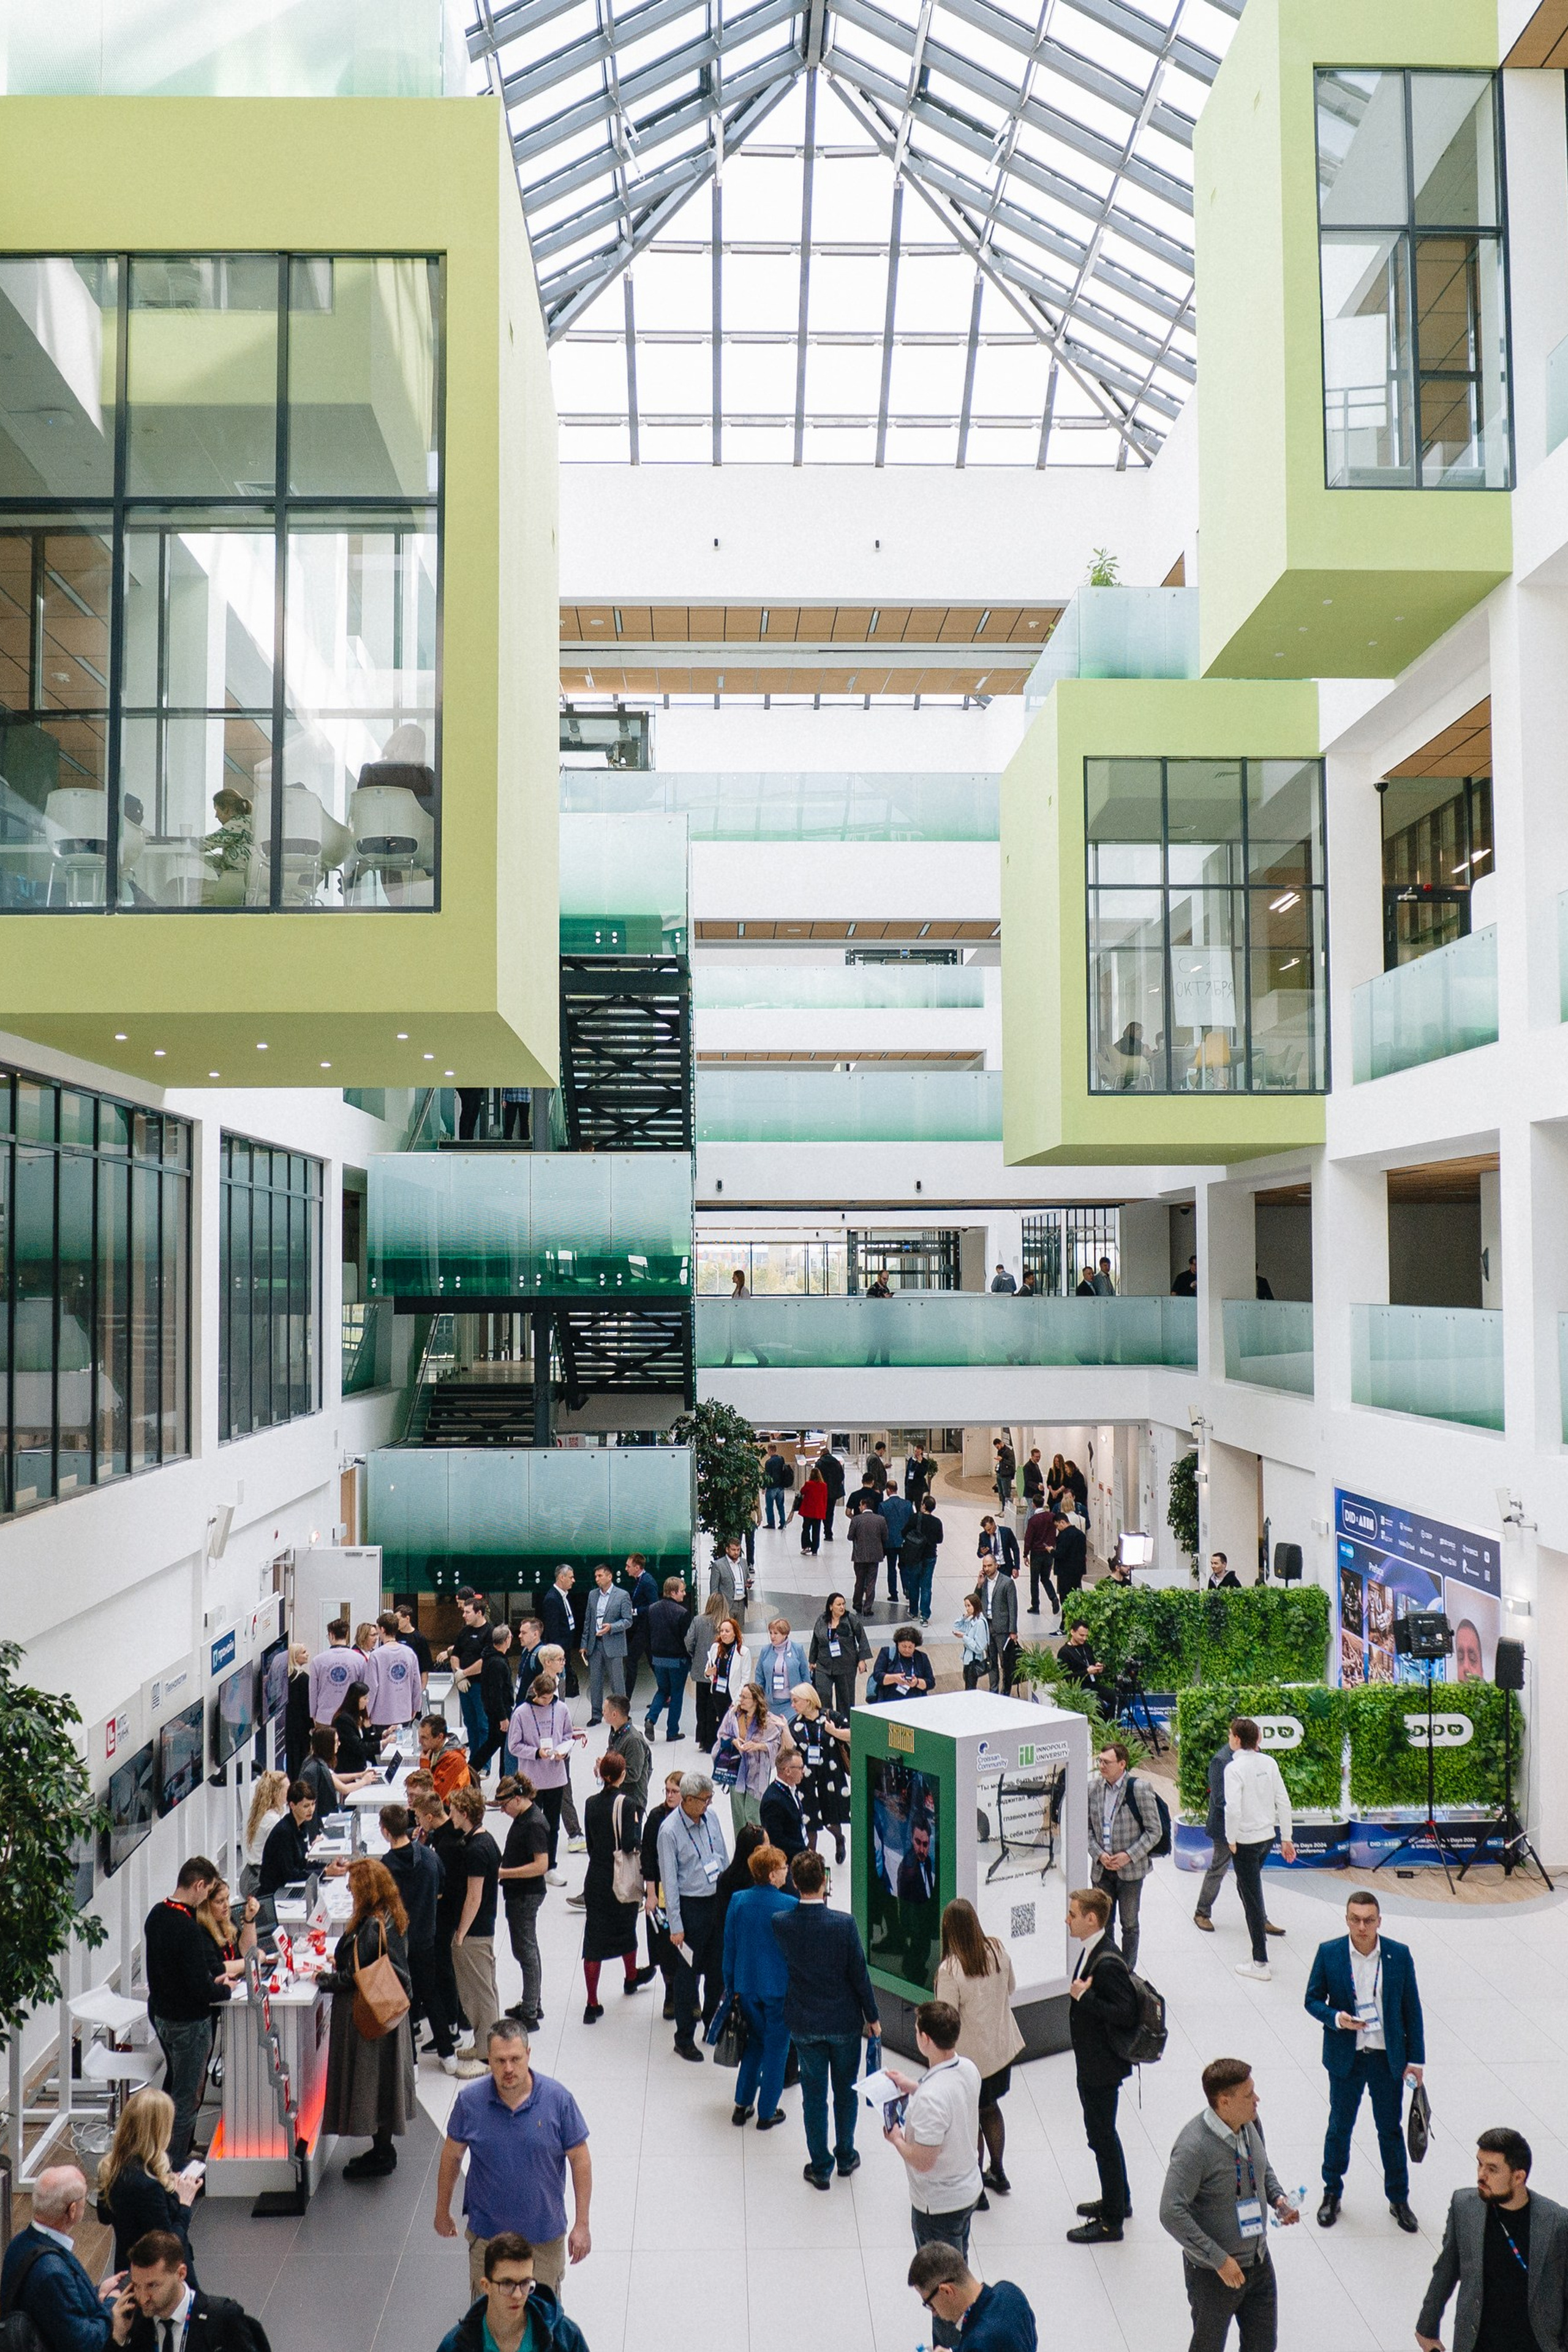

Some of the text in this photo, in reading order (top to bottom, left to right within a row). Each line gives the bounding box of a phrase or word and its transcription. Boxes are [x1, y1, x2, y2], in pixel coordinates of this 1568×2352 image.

[1177, 981, 1233, 998] ОКТЯБРЯ
[1036, 1743, 1066, 1753] INNOPOLIS
[1036, 1751, 1069, 1761] UNIVERSITY
[978, 1760, 1007, 1770] Community
